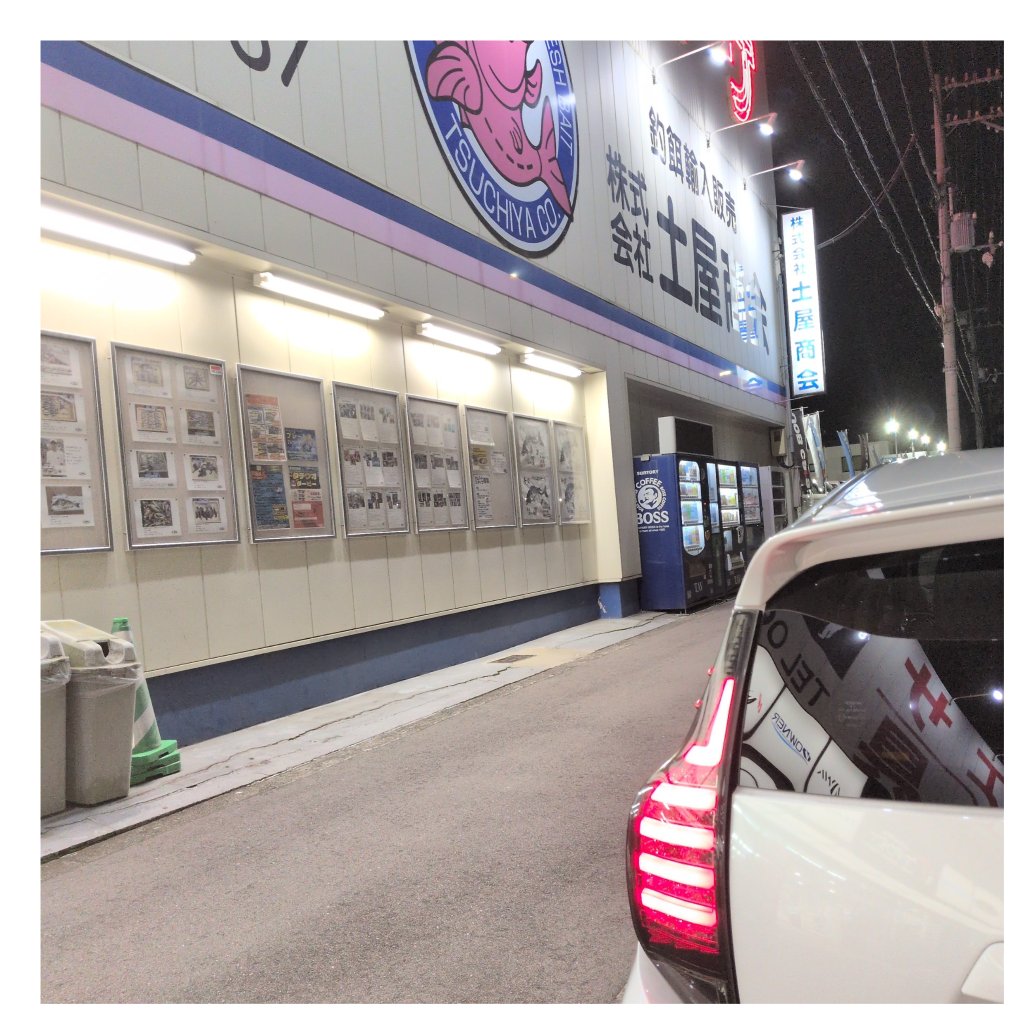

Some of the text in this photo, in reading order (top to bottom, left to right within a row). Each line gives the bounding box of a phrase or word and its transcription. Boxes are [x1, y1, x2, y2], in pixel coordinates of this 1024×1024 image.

[557, 94, 573, 156] BAIT
[445, 112, 561, 239] TSUCHIYA CO.
[649, 106, 737, 234] 釣餌輸入販売
[635, 477, 663, 489] COFFEE
[637, 510, 670, 525] BOSS
